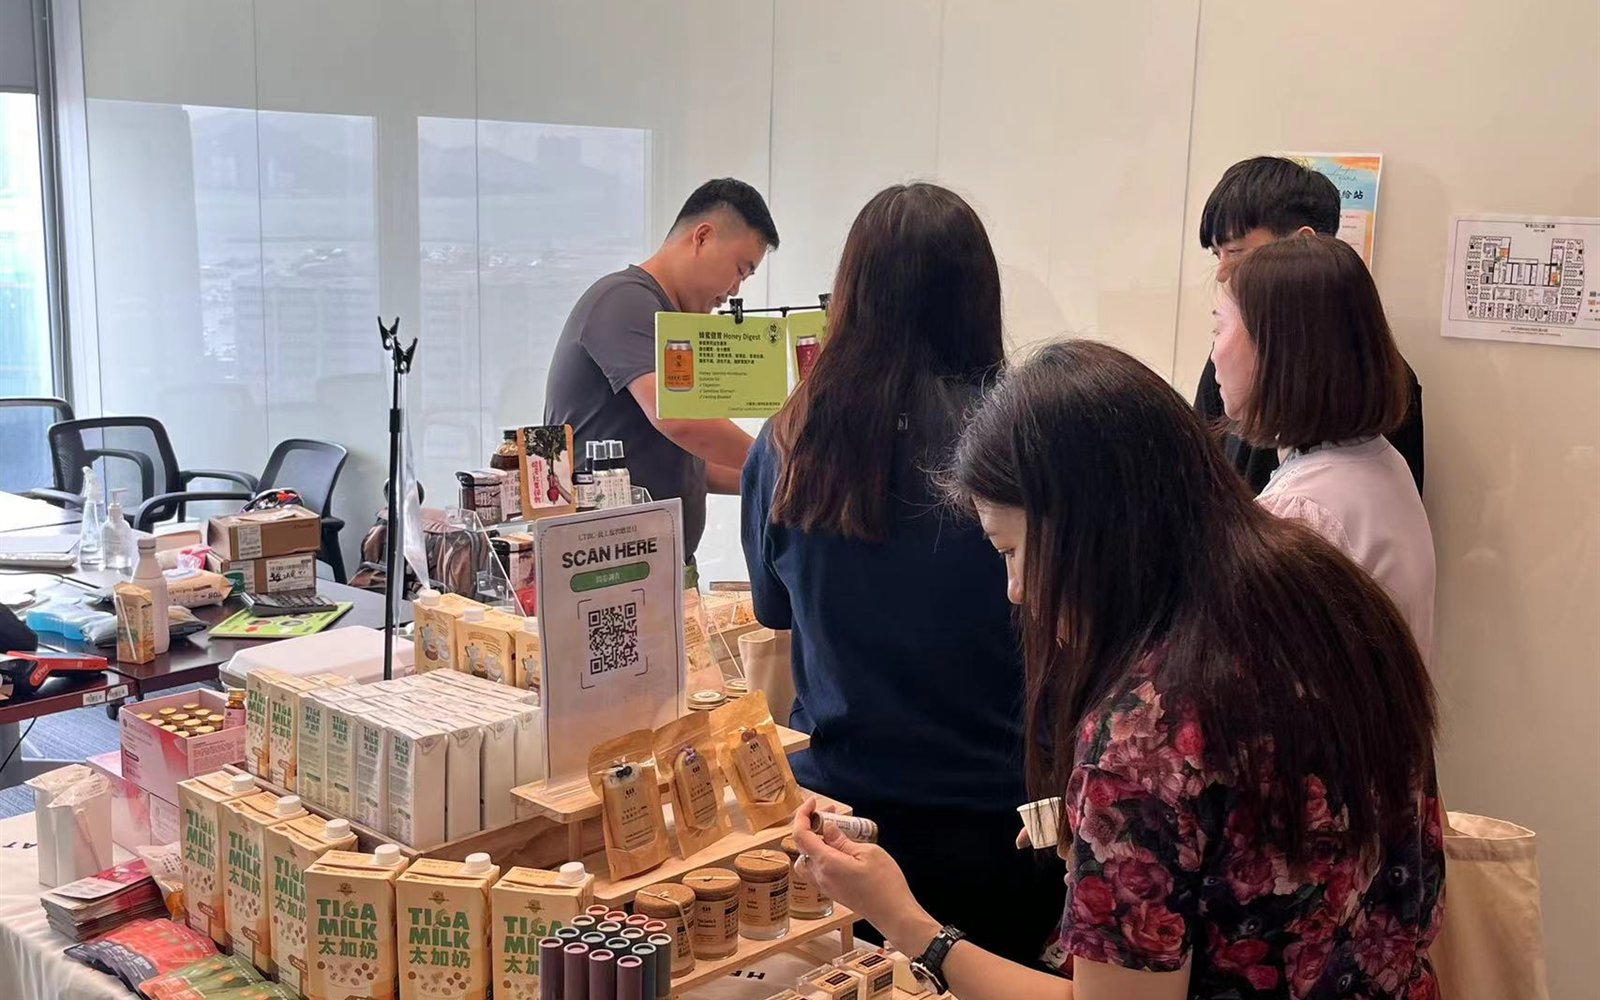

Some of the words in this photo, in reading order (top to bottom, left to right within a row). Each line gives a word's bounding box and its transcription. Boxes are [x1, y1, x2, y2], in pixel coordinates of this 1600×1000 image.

[723, 332, 742, 341] Honey
[743, 333, 761, 342] Digest
[562, 545, 611, 569] SCAN
[615, 537, 658, 560] HERE
[272, 701, 291, 718] TIGA
[272, 712, 291, 730] MILK
[186, 809, 216, 837] TIGA
[186, 826, 216, 855] MILK
[228, 831, 261, 863] TIGA
[185, 845, 216, 873] 太加奶
[228, 849, 261, 880] MILK
[228, 868, 261, 898] 太加奶
[316, 898, 377, 922] TIGA
[408, 907, 470, 931] TIGA
[317, 918, 378, 941] MILK
[409, 926, 470, 950] MILK
[318, 937, 378, 960] 太加奶
[504, 935, 539, 956] MI
[409, 946, 471, 970] 太加奶
